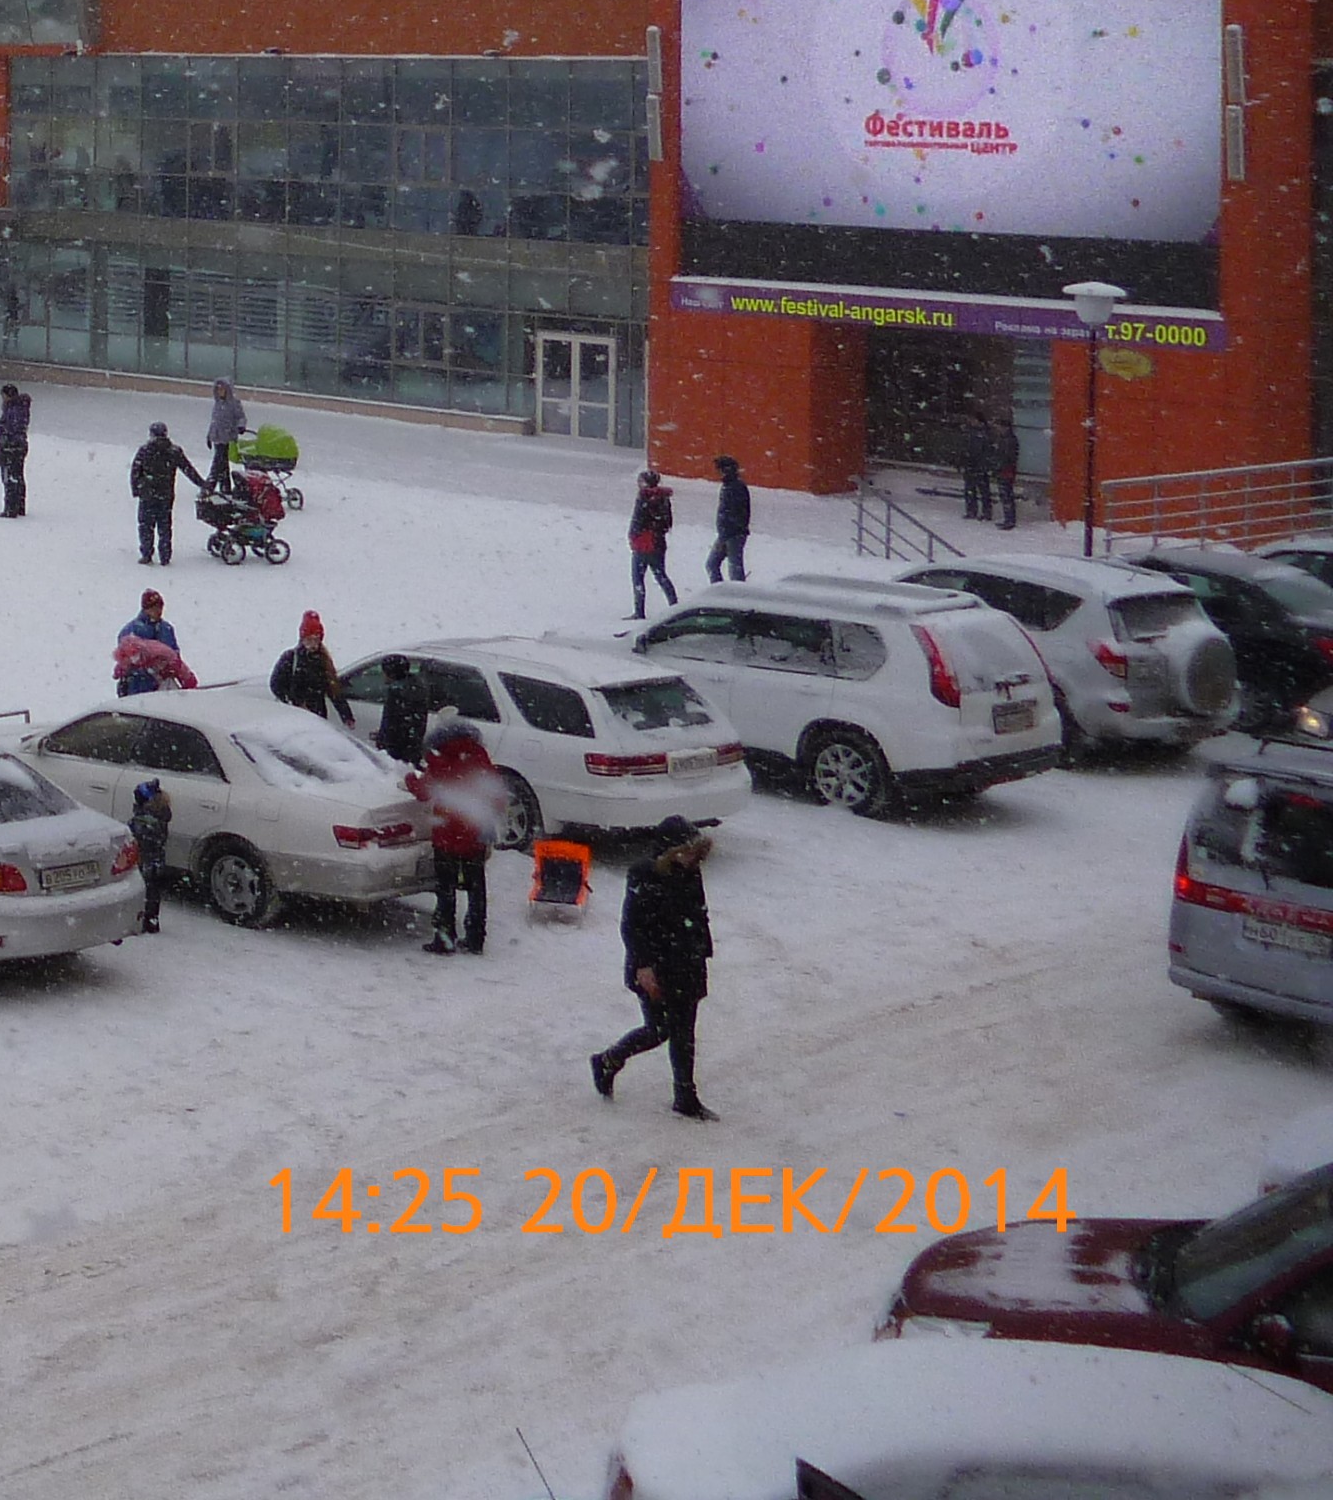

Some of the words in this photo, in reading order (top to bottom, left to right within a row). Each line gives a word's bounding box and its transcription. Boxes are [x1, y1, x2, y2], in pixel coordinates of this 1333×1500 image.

[864, 109, 1010, 139] Фестиваль
[731, 296, 953, 327] www.festival-angarsk.ru
[1104, 321, 1207, 347] т.97-0000
